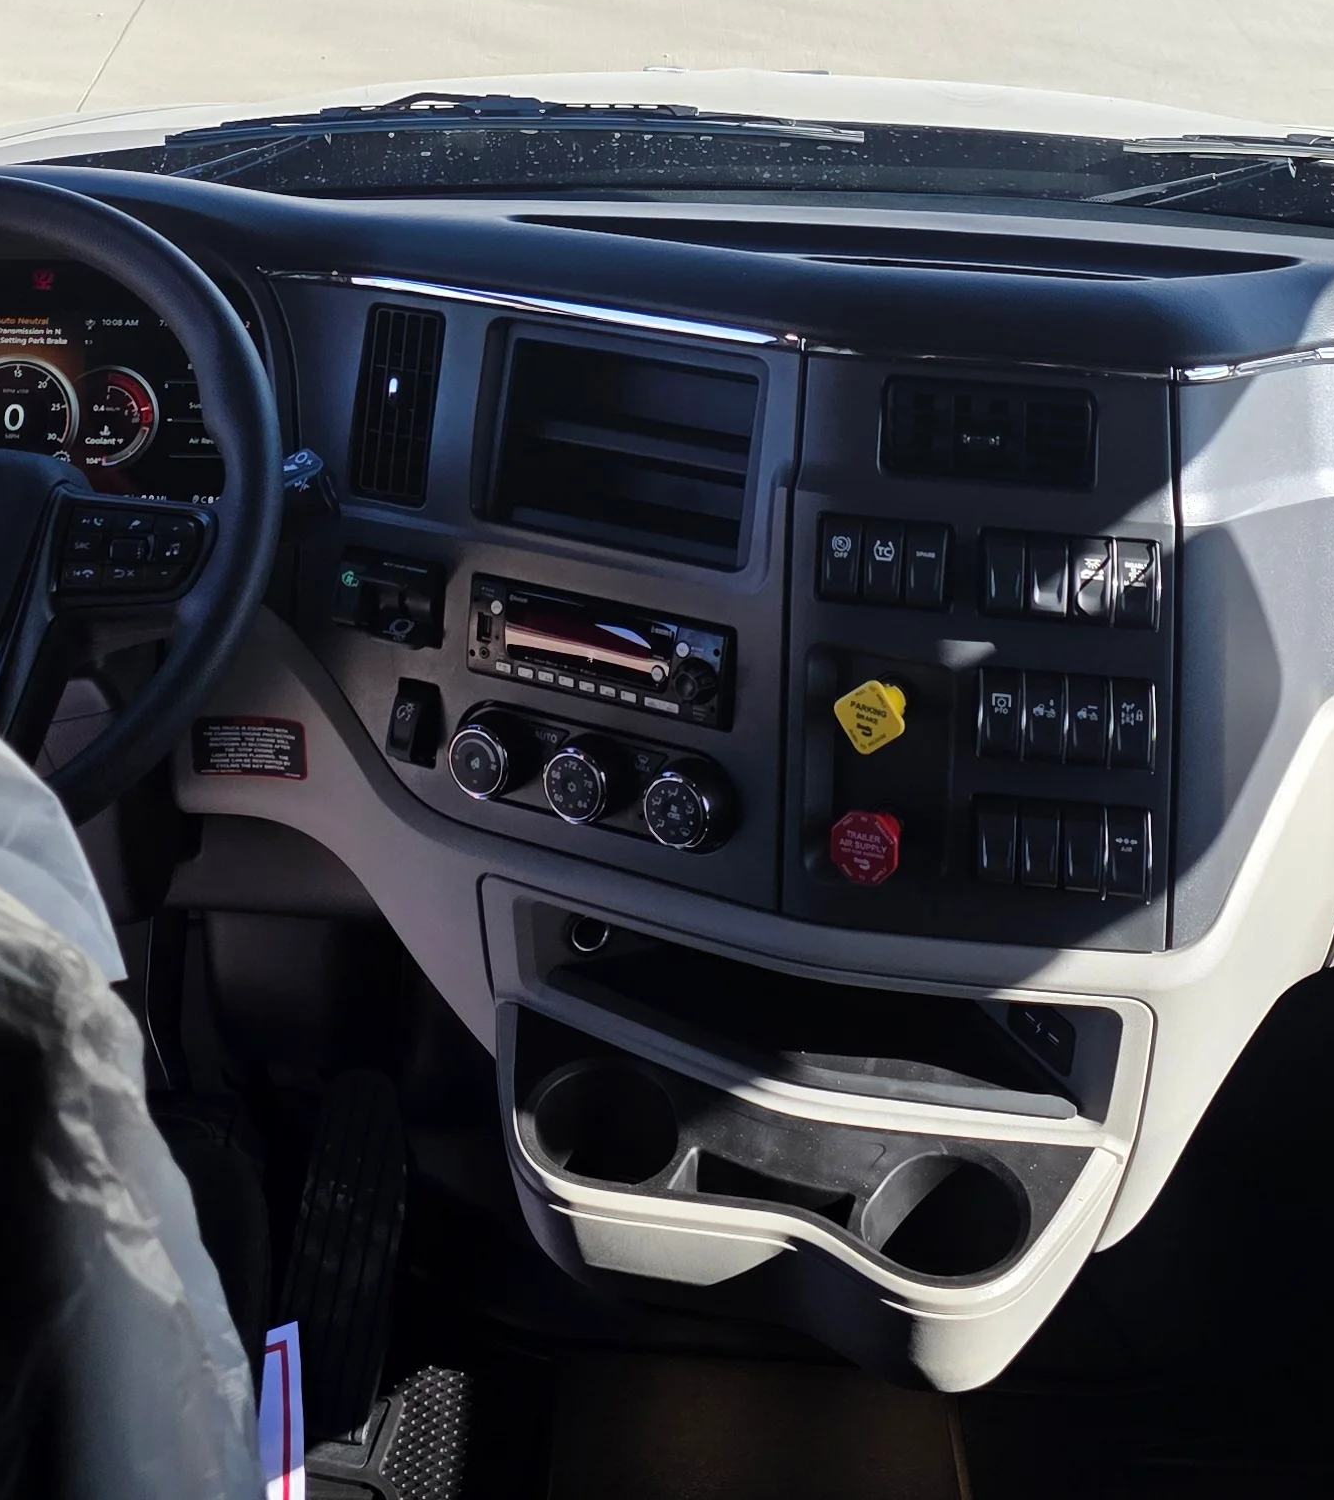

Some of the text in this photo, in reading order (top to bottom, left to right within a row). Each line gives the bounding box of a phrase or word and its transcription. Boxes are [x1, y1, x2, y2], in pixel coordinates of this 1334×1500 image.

[18, 317, 50, 325] Neutral
[102, 319, 124, 327] 10:08
[0, 337, 27, 346] Setting
[46, 337, 68, 345] Brake
[13, 370, 22, 378] 15
[37, 380, 47, 389] 20
[50, 403, 61, 411] 25
[4, 403, 25, 431] 0
[85, 437, 116, 445] Coolant
[74, 541, 91, 550] SRC
[834, 551, 849, 559] OFF
[877, 546, 892, 557] TC
[850, 701, 887, 718] PARKING
[856, 712, 878, 725] BRAKE
[262, 732, 295, 740] PROTECTION
[534, 730, 558, 743] AUTO
[567, 760, 578, 770] 72
[847, 830, 881, 844] TRAILER
[839, 838, 887, 854] AIR SUPPLY
